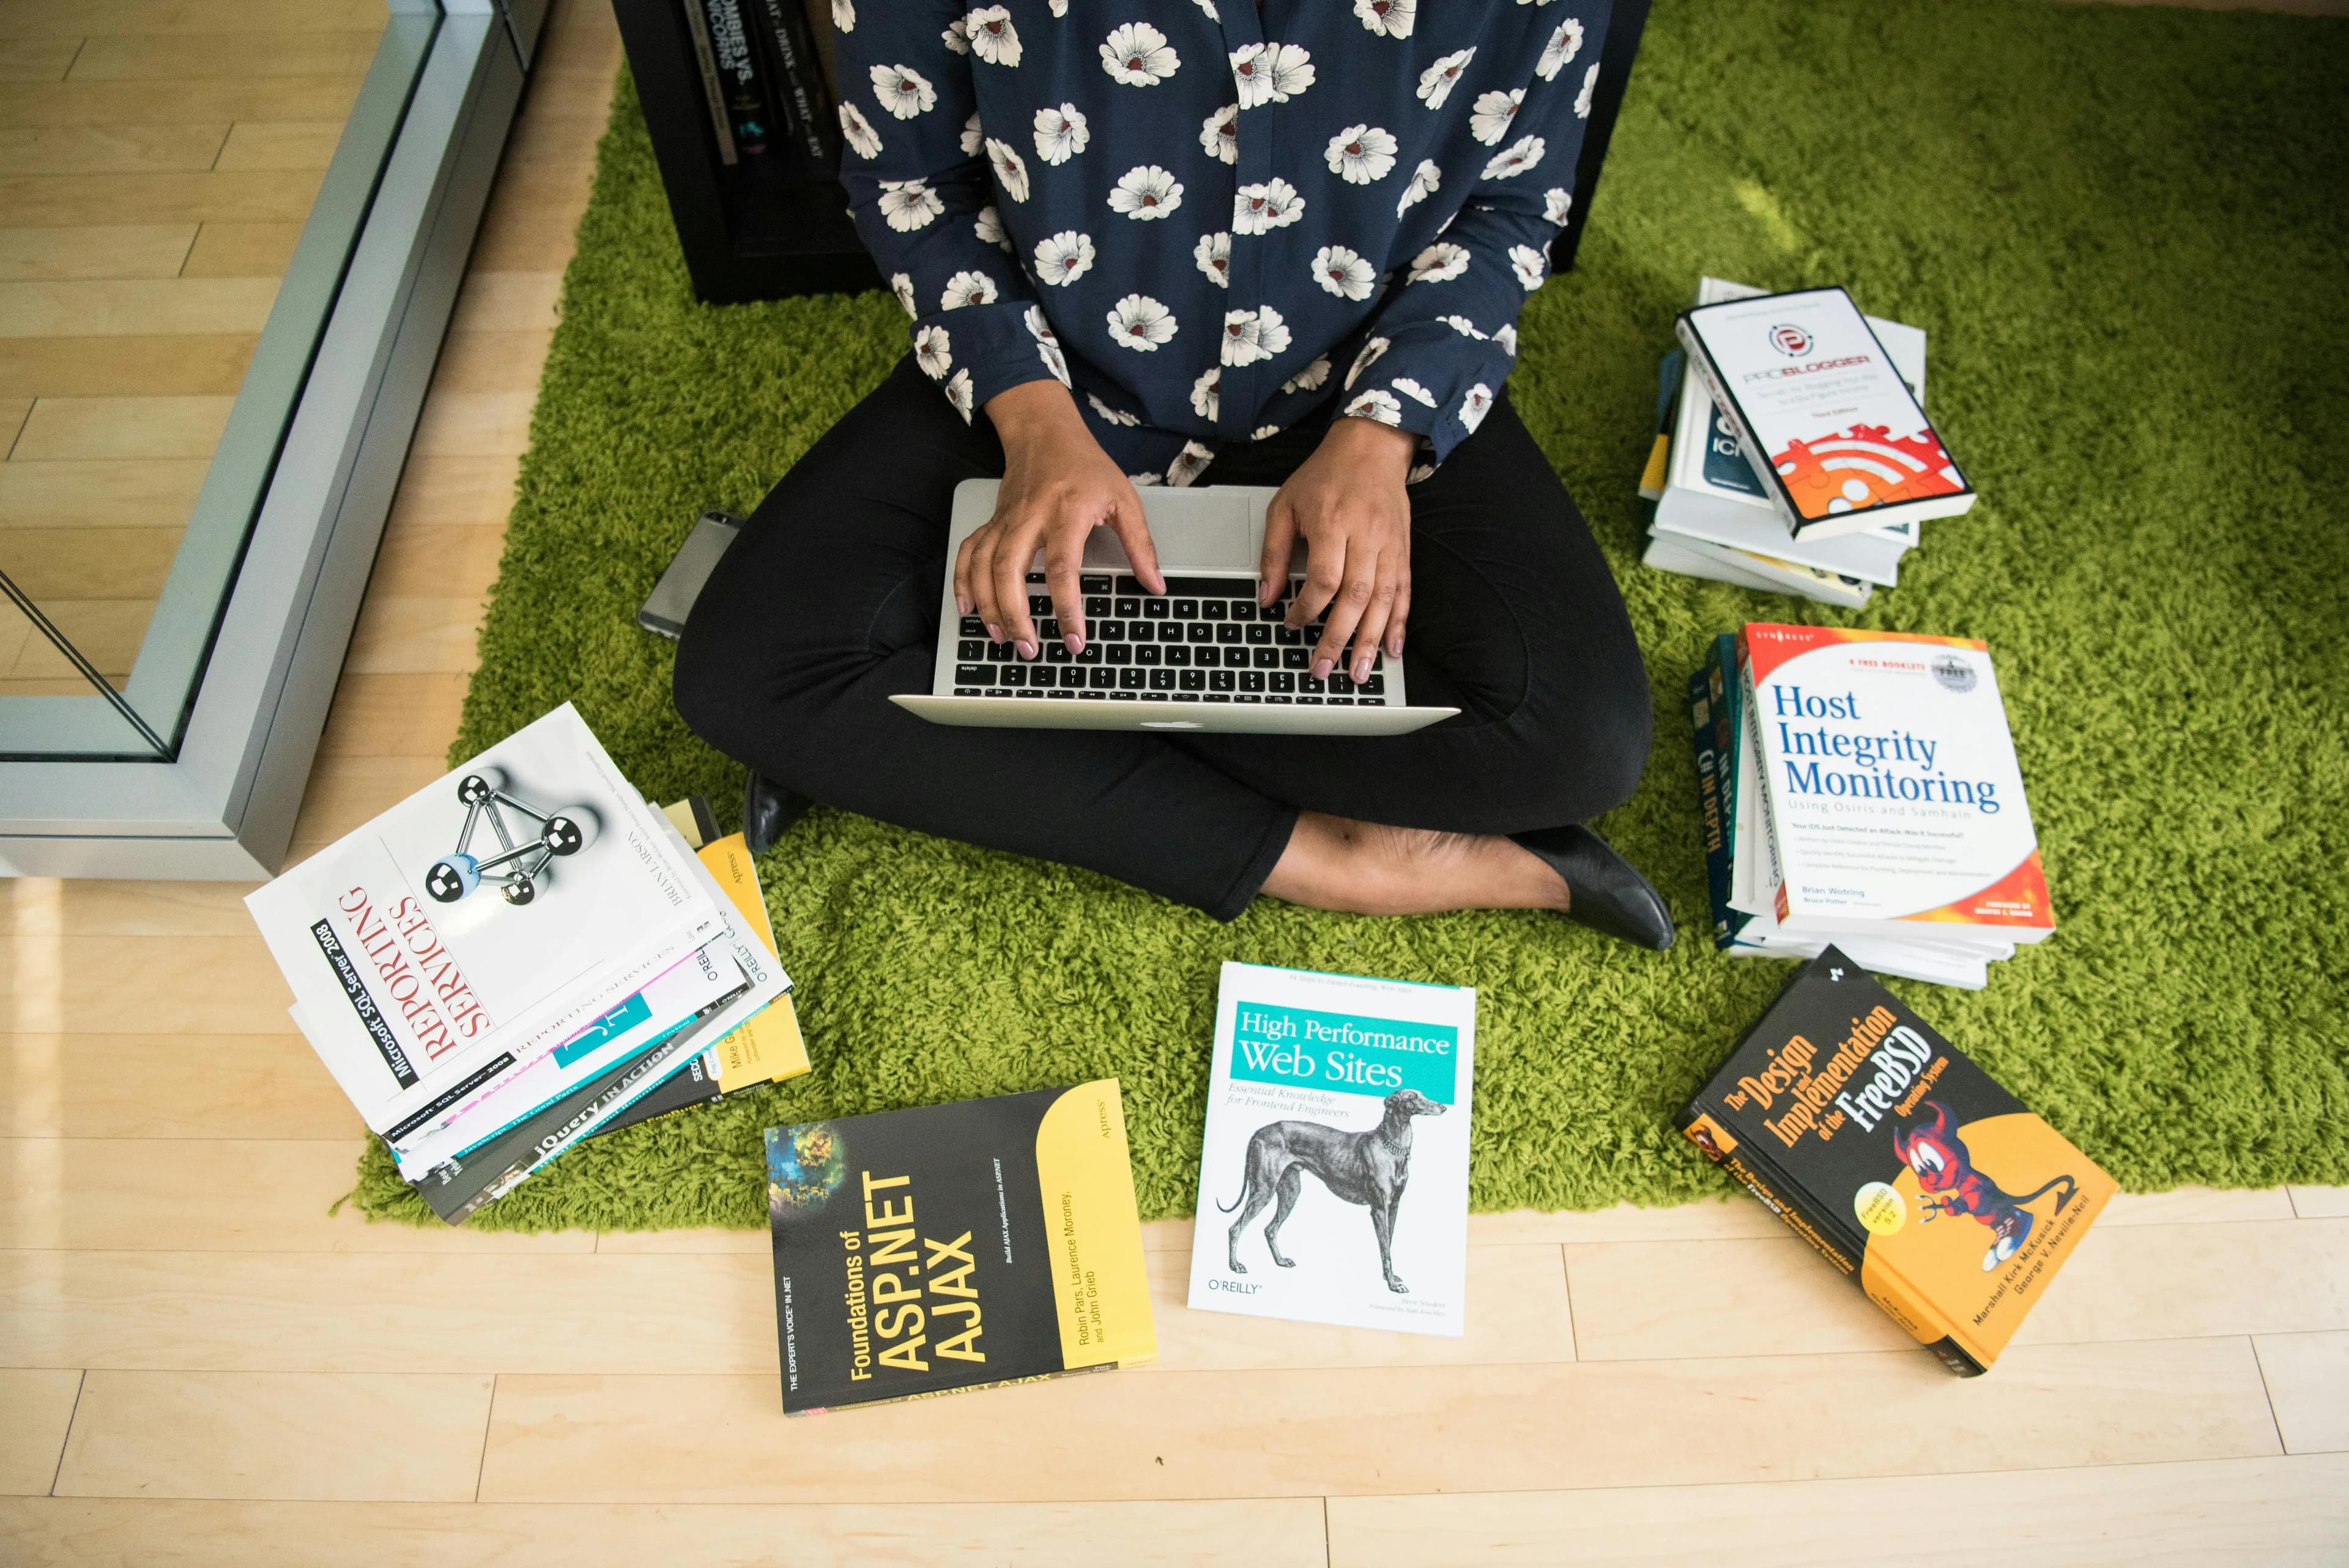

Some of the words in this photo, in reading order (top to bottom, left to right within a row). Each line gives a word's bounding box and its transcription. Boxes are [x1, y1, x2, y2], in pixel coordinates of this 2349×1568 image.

[1858, 658, 1878, 667] FREE
[1882, 660, 1925, 672] BOOKLETS
[1772, 685, 1860, 719] Host
[1698, 751, 1714, 773] C#
[1778, 723, 1937, 770] Integrity
[1701, 775, 1714, 794] IN
[1747, 710, 1768, 781] INTEGRITY
[1760, 782, 1780, 886] MONITORING
[1783, 760, 2000, 814] Monitoring
[1703, 798, 1722, 852] DEPTH
[1789, 800, 1829, 813] Using
[1835, 802, 1876, 814] Osiris
[1881, 805, 1904, 816] and
[1911, 806, 1972, 820] Samhain
[626, 830, 658, 874] LARSON
[725, 852, 745, 885] Apress
[655, 871, 682, 907] BRIAN
[1802, 886, 1825, 894] Brian
[1828, 887, 1865, 897] Wotring
[316, 924, 340, 953] 2008
[332, 955, 362, 994] Server
[338, 886, 457, 1061] REPORTING
[389, 896, 491, 1037] SERVICES
[735, 941, 768, 984] O'REILLY
[354, 990, 376, 1018] SQL
[515, 993, 604, 1054] REPORTING
[604, 946, 675, 993] SERVICES
[368, 1019, 411, 1078] Microsoft
[1241, 1012, 1297, 1039] High
[1305, 1019, 1450, 1055] Performance
[726, 1045, 743, 1069] Mike
[1239, 1040, 1315, 1077] Web
[1325, 1051, 1402, 1088] Sites
[1724, 1090, 1749, 1112] The
[1737, 1035, 1817, 1110] Design
[1228, 1082, 1274, 1098] Essential
[1277, 1088, 1335, 1107] Knowledge
[1764, 1005, 1897, 1148] Implementation
[1795, 1074, 1813, 1093] and
[1836, 1025, 1932, 1132] FreeBSD
[1895, 1076, 1933, 1120] Operating
[1920, 1054, 1950, 1085] System
[391, 1107, 433, 1137] Microsoft
[435, 1093, 455, 1108] SQL
[454, 1074, 483, 1095] Server
[487, 1056, 510, 1073] 2008
[511, 1113, 529, 1126] The
[529, 1098, 554, 1116] Good
[554, 1083, 578, 1101] Parts
[533, 1100, 603, 1158] jQuery
[603, 1087, 620, 1103] IN
[622, 1042, 674, 1088] ACTION
[1224, 1093, 1243, 1107] for
[1245, 1096, 1294, 1112] Frontend
[1297, 1104, 1350, 1120] Engineers
[1097, 1101, 1111, 1139] Apress
[1817, 1123, 1835, 1142] of
[1827, 1110, 1847, 1131] the
[998, 1191, 1009, 1230] Applications
[1059, 1191, 1075, 1236] Moroney,
[1729, 1157, 1748, 1175] The
[1745, 1172, 1775, 1200] Design
[1773, 1197, 1791, 1214] and
[1788, 1211, 1856, 1273] Implementation
[1746, 1183, 1782, 1216] FreeBSD
[1861, 1187, 1888, 1220] FreeBSD
[1873, 1198, 1893, 1225] version
[839, 1229, 861, 1251] of
[2014, 1258, 2046, 1296] George
[2039, 1247, 2052, 1259] V.
[2046, 1194, 2091, 1249] Neville-Neil
[861, 1170, 929, 1371] ASP.NET
[1066, 1239, 1081, 1285] Laurence
[1973, 1283, 2008, 1326] Marshall
[2004, 1261, 2023, 1284] Kirk
[2019, 1218, 2055, 1263] McKusick
[785, 1295, 792, 1303] IN
[924, 1231, 985, 1362] AJAX
[1072, 1287, 1086, 1313] Pars,
[1083, 1271, 1097, 1298] Grieb
[1209, 1280, 1258, 1295] O'REILLY
[845, 1256, 872, 1380] Foundations
[1075, 1316, 1089, 1345] Robin
[1088, 1300, 1101, 1326] John
[787, 1334, 796, 1372] EXPERT'S
[1094, 1328, 1104, 1342] and
[907, 1381, 991, 1400] ASP.NET
[998, 1372, 1051, 1388] AJAX
